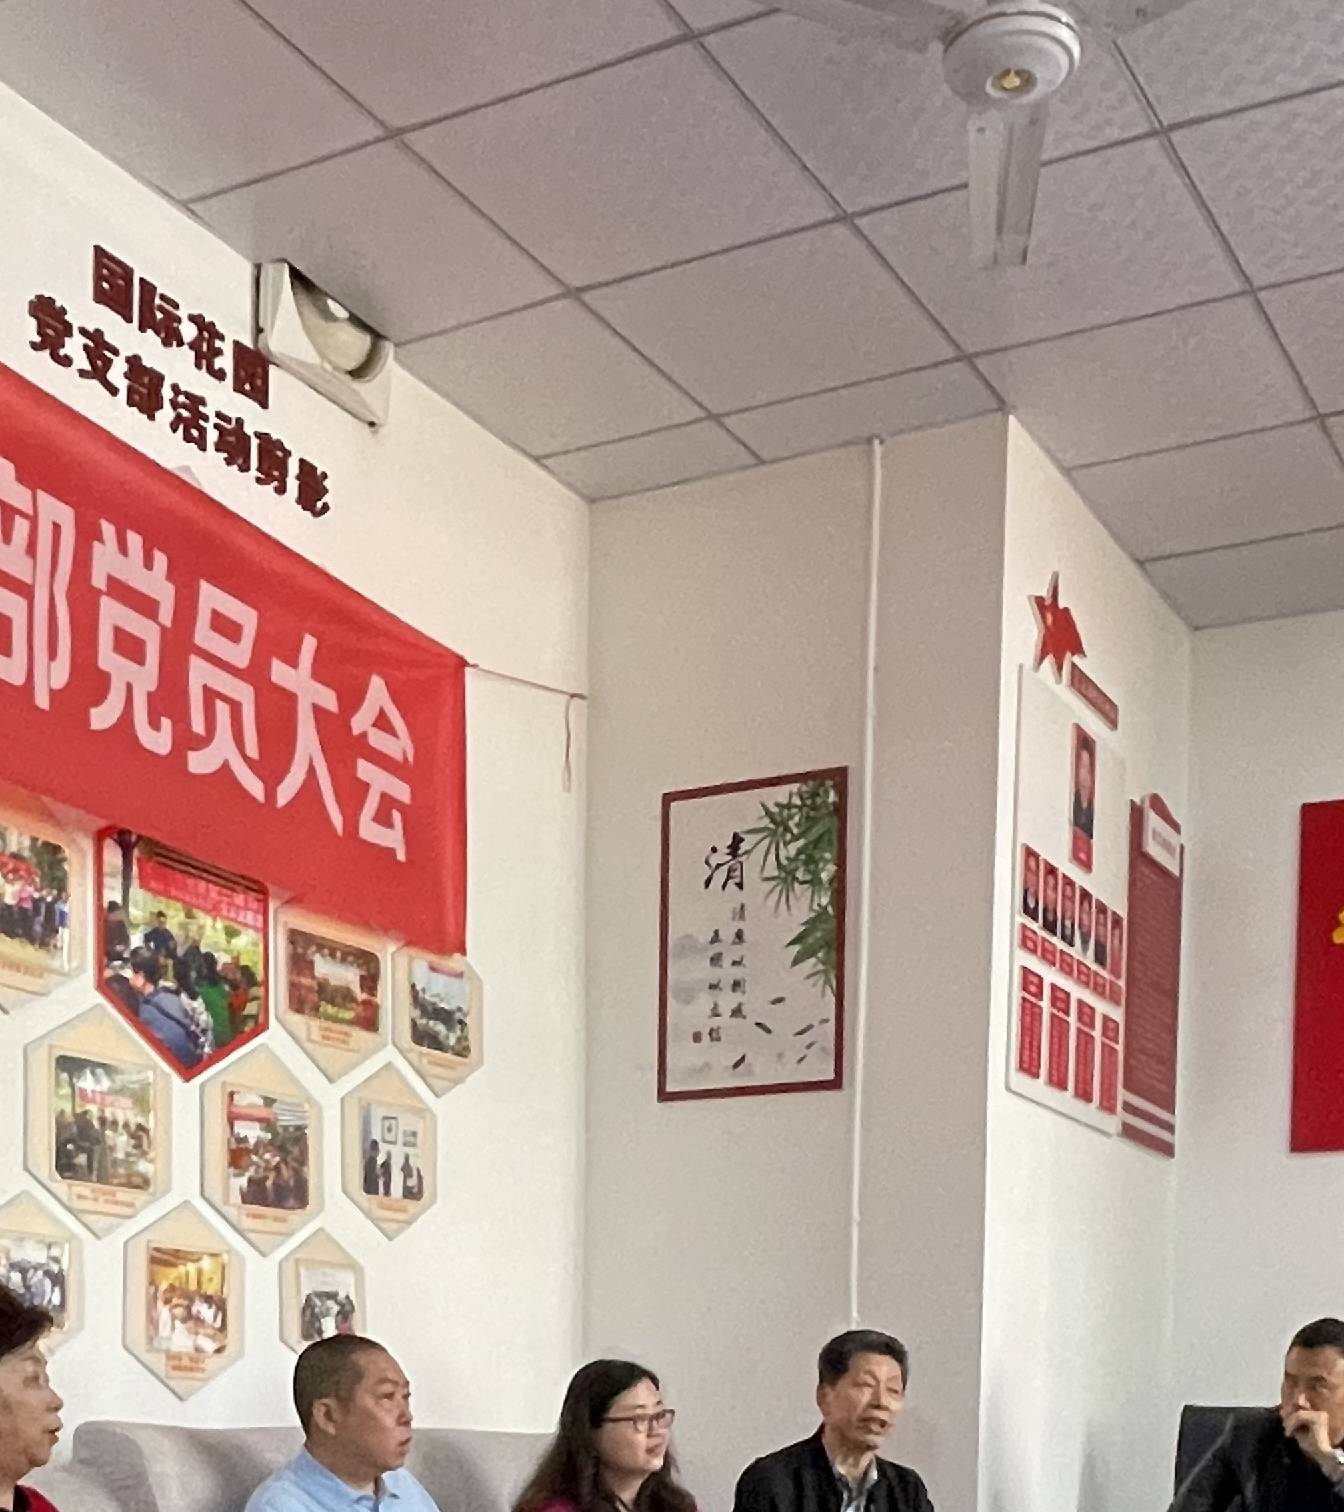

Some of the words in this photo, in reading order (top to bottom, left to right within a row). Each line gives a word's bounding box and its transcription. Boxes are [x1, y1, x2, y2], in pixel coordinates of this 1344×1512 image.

[28, 294, 331, 518] 党支部活动剪影
[93, 244, 270, 409] 国际花园
[704, 831, 745, 891] 清
